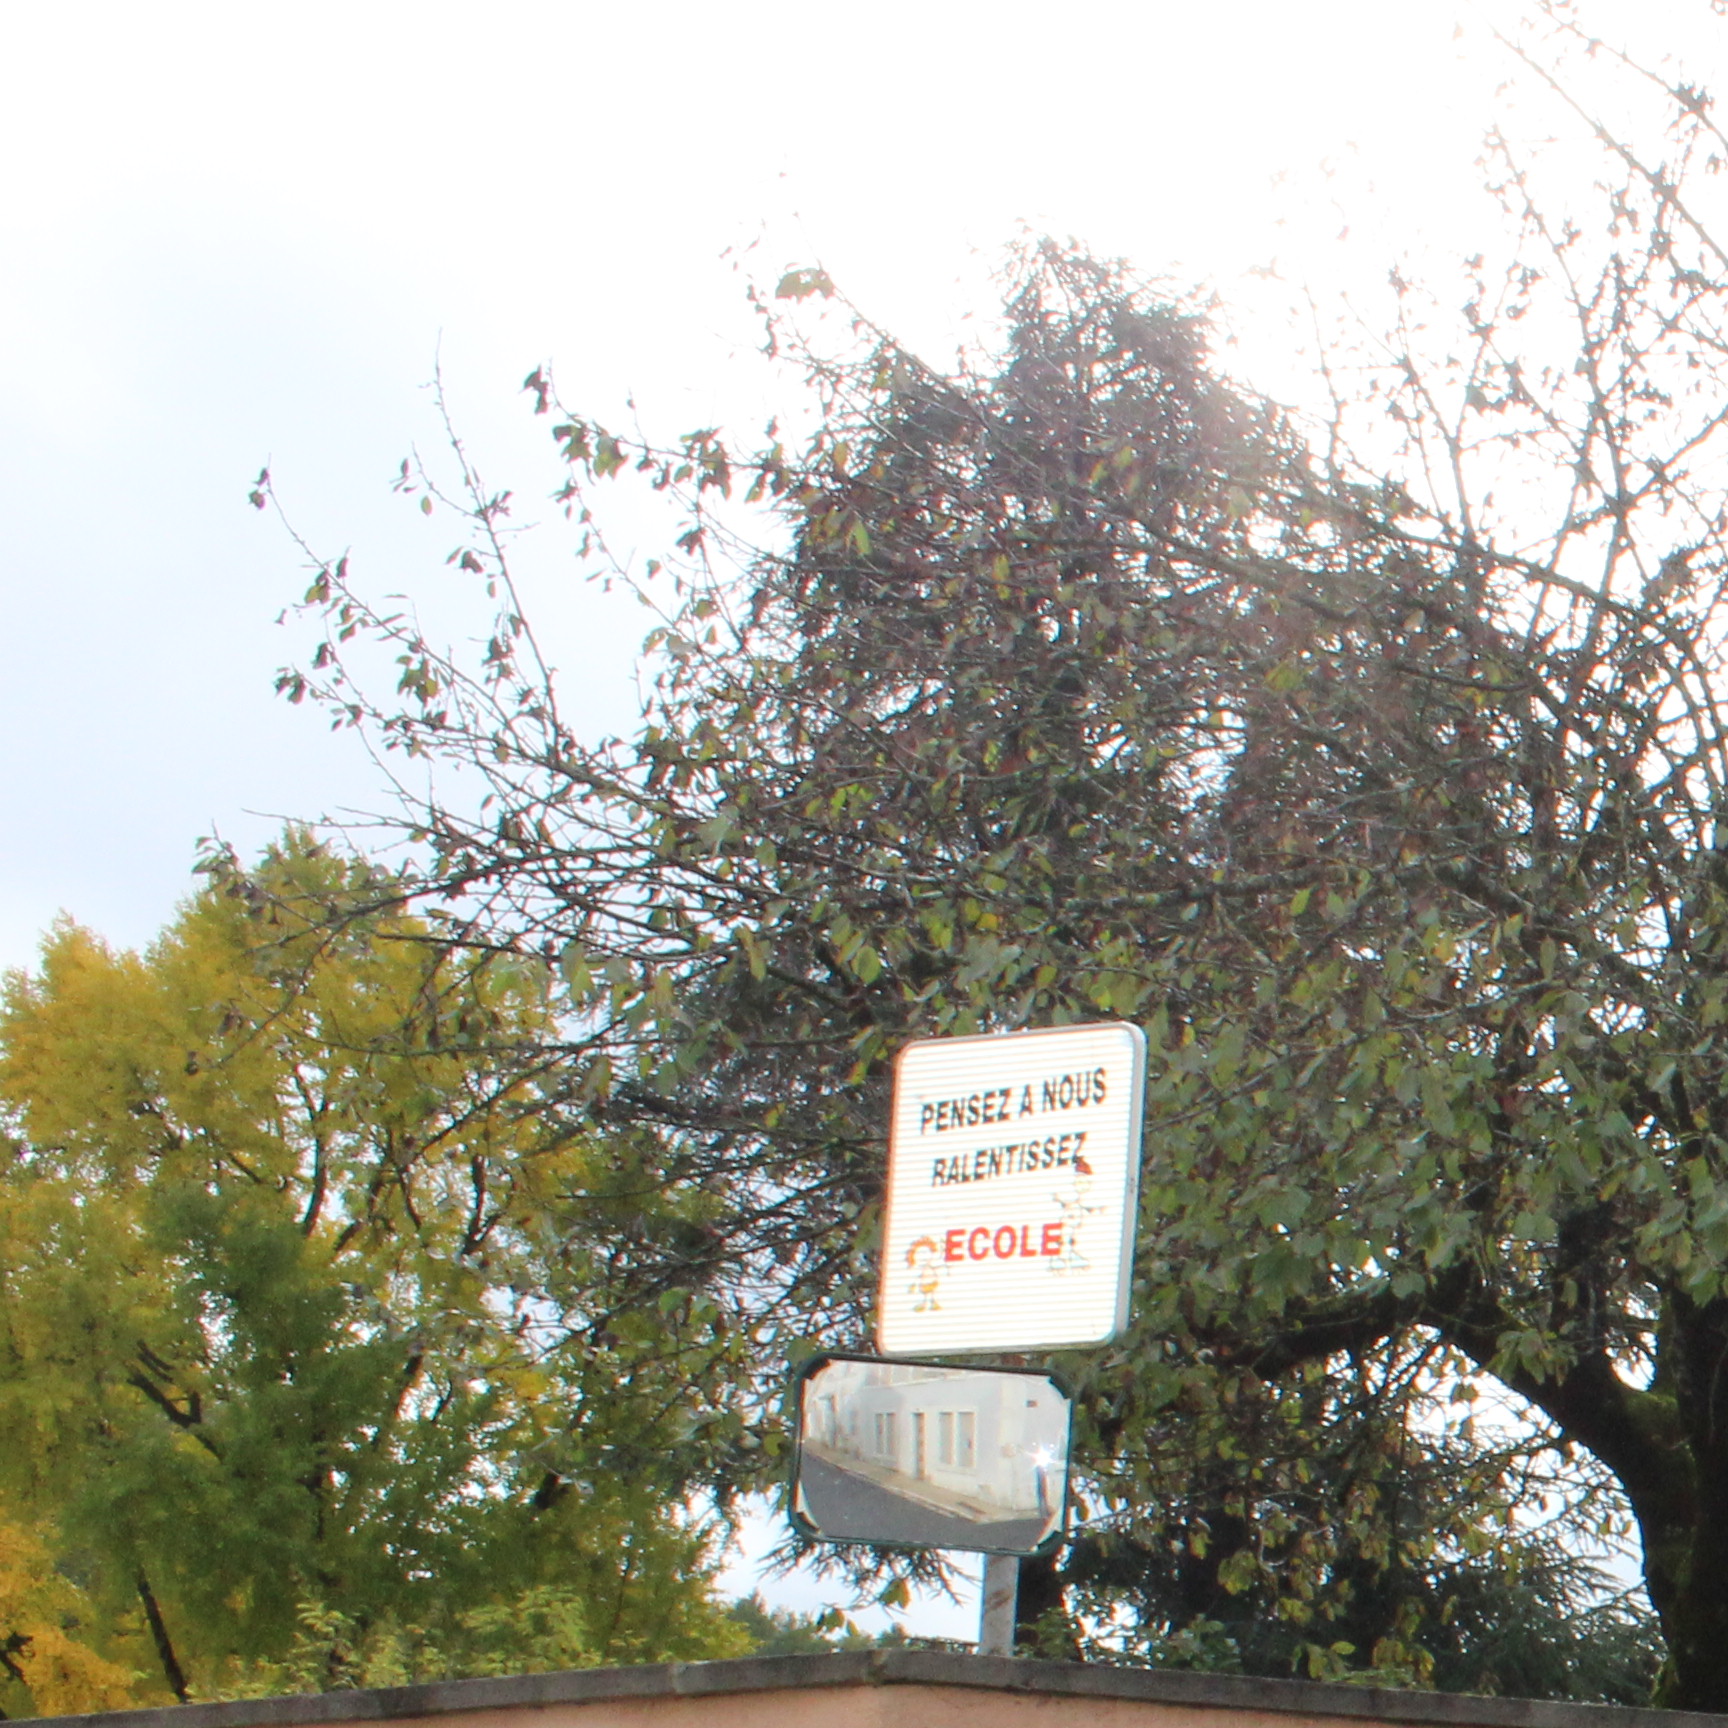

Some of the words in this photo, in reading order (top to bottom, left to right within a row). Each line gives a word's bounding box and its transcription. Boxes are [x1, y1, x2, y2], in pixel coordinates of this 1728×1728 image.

[920, 1088, 1012, 1136] PENSEZ
[1019, 1084, 1035, 1120] A
[1041, 1067, 1107, 1112] NOUS
[931, 1131, 1088, 1188] RALENTISSEZ
[944, 1222, 1064, 1263] ECOLE
